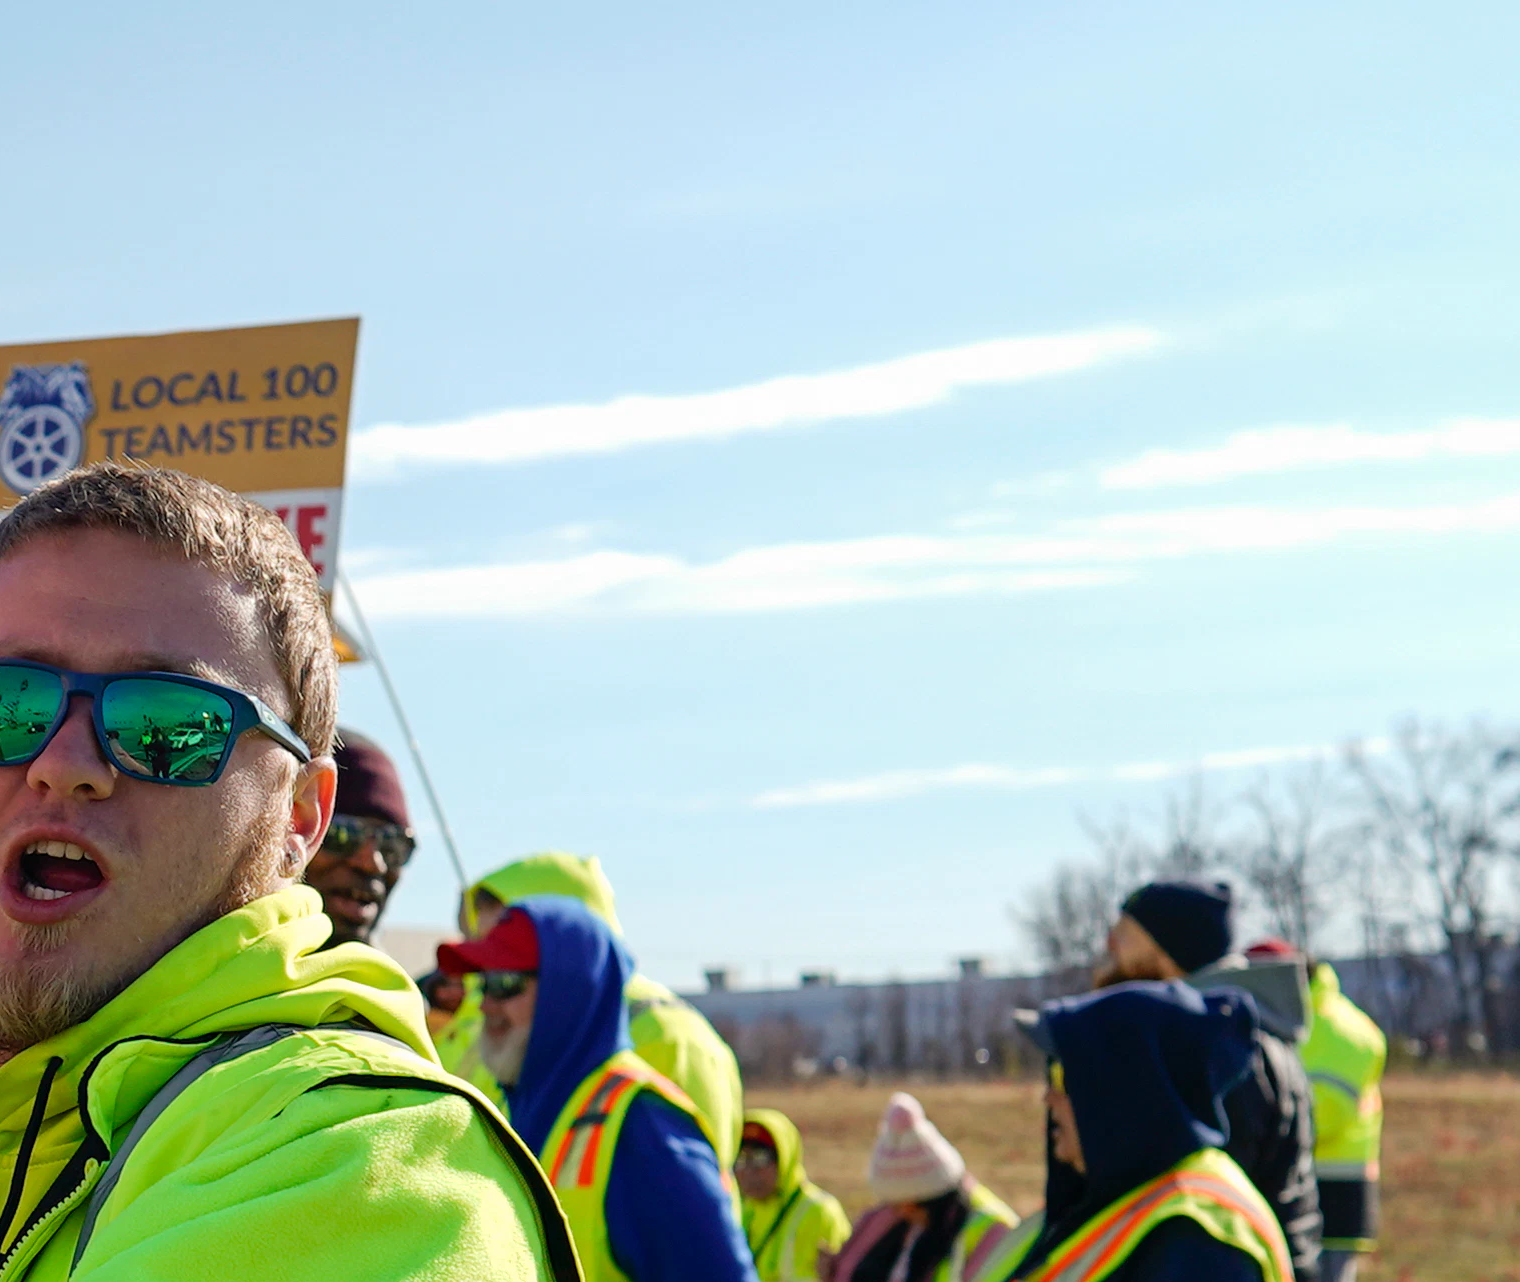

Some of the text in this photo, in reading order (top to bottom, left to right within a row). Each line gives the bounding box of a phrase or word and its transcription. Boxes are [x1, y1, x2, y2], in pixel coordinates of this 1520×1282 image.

[110, 362, 339, 412] LOCAL 100
[100, 414, 339, 459] TEAMSTERS
